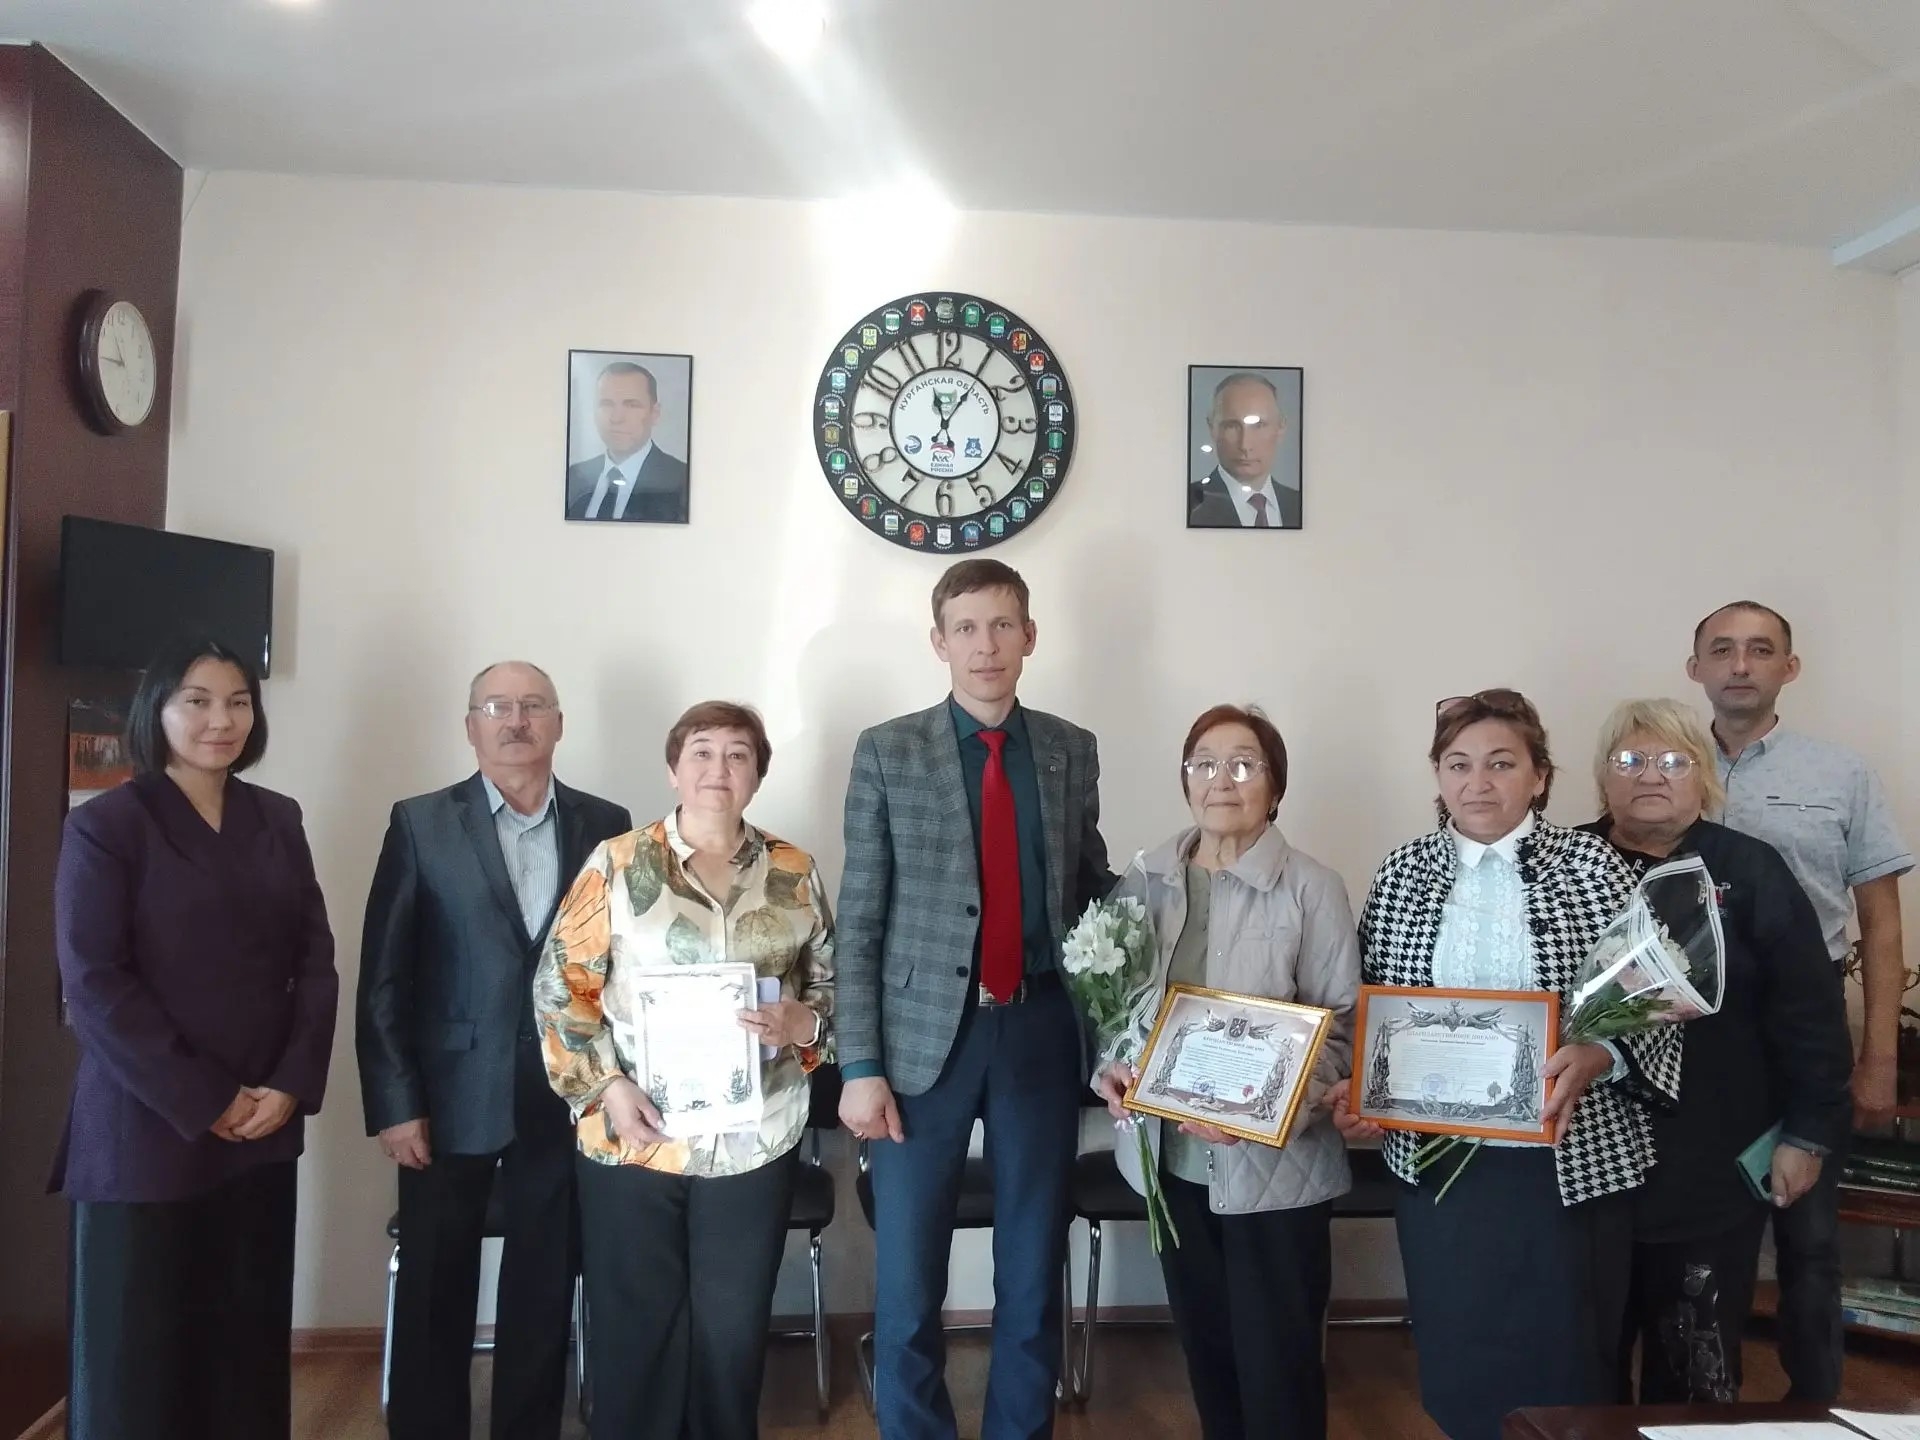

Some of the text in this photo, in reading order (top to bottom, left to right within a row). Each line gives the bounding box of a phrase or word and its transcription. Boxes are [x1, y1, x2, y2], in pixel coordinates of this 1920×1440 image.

[936, 329, 962, 368] 12
[899, 377, 954, 411] КУРГАНСКАЯ
[862, 446, 897, 473] 8
[935, 479, 953, 518] 6
